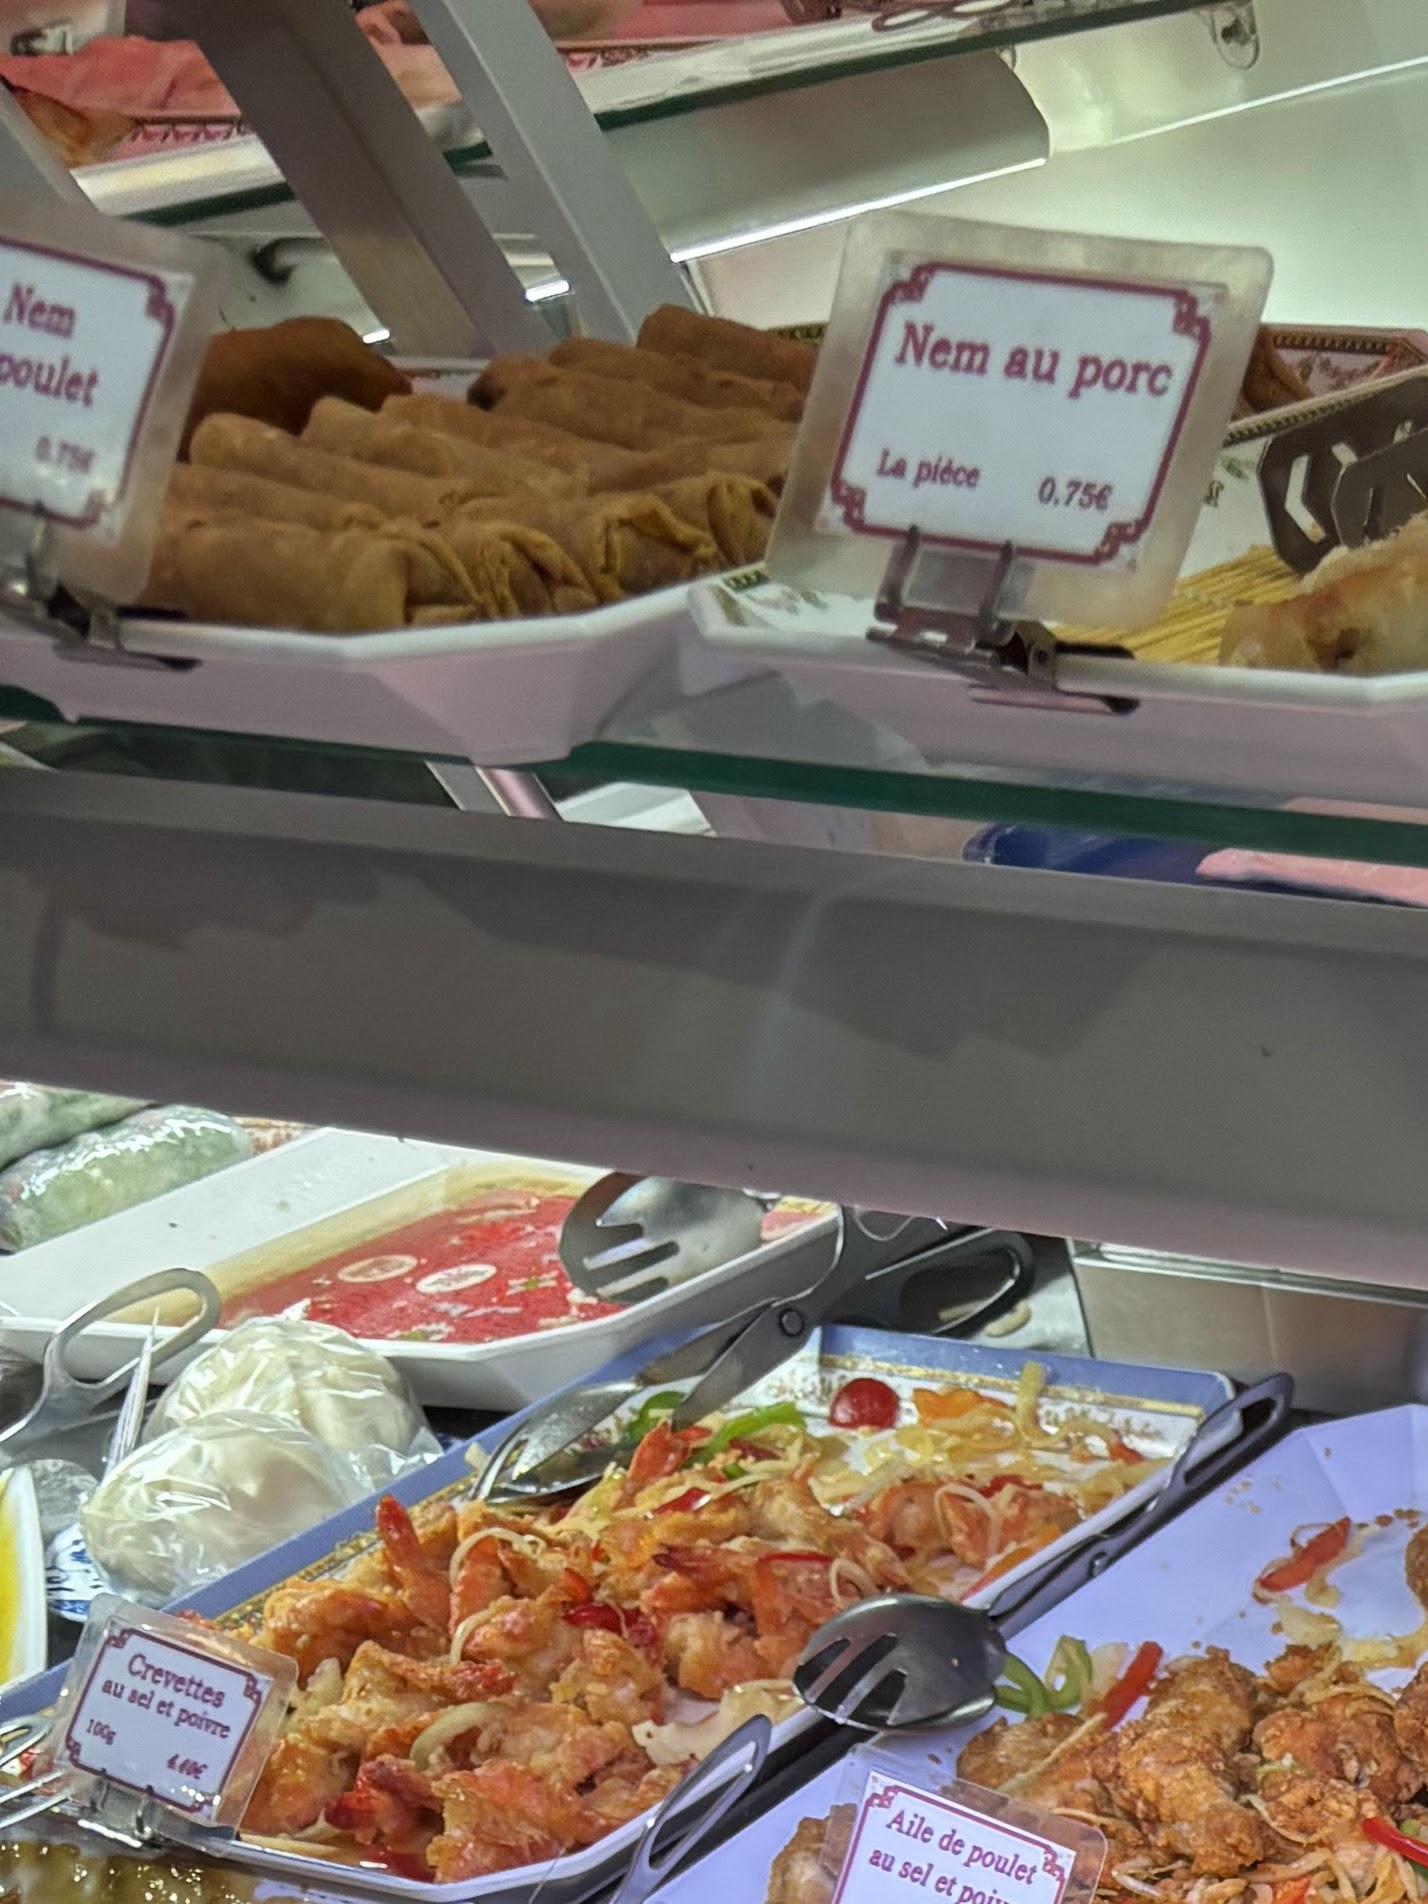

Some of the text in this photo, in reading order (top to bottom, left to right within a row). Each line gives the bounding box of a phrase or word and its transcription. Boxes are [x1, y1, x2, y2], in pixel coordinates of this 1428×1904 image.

[3, 281, 76, 339] Nem
[895, 319, 1173, 400] Nem au porc
[876, 449, 906, 479] La
[1037, 476, 1113, 511] 0.75€
[102, 1679, 231, 1739] au sel et poivre
[128, 1653, 225, 1708] Crevettes
[86, 1718, 117, 1746] 100g
[869, 1849, 896, 1872] au
[899, 1861, 933, 1887] sel
[934, 1874, 958, 1896] et
[886, 1809, 1037, 1885] Aile de poulet
